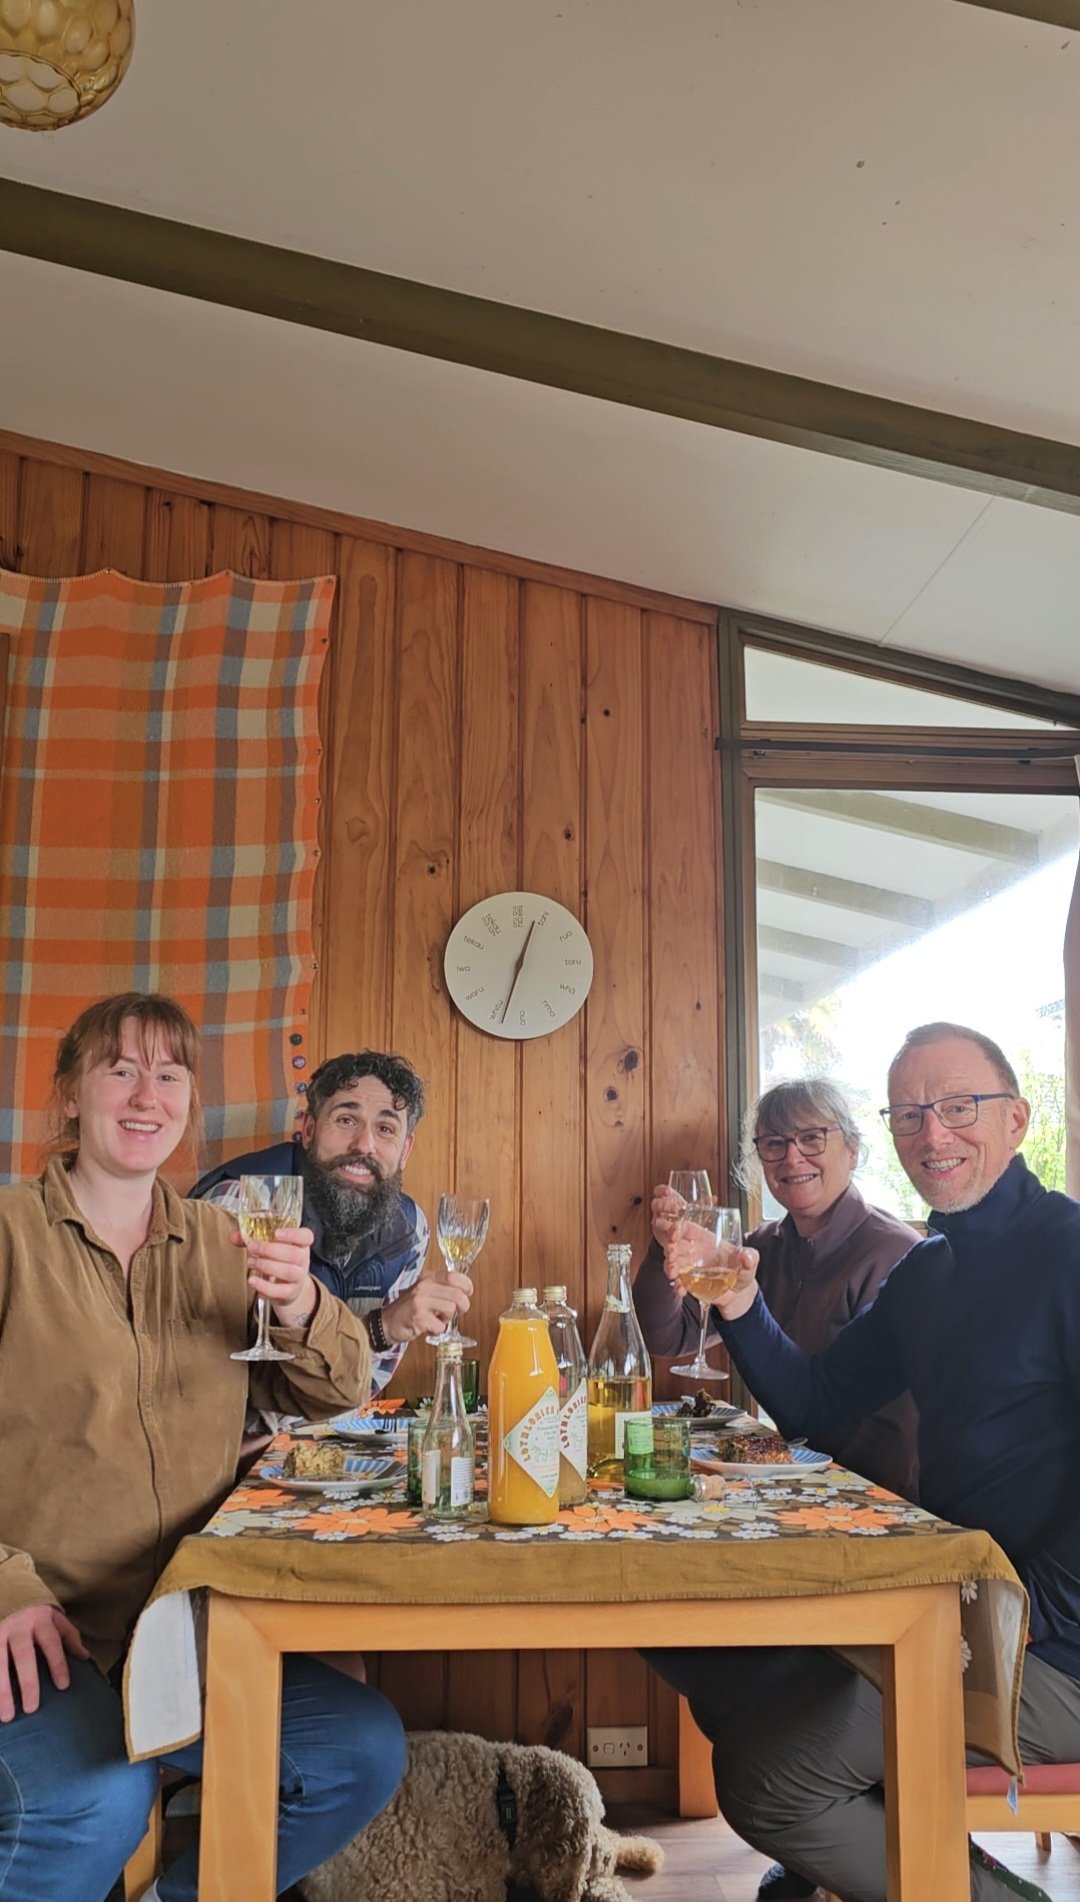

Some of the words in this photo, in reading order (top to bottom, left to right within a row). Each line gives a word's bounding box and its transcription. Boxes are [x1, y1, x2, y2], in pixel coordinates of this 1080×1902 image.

[463, 935, 485, 950] tekau
[559, 930, 572, 942] rua
[564, 958, 581, 966] toru
[465, 987, 485, 1001] waru
[489, 1000, 504, 1020] whitu
[542, 1000, 556, 1017] rima
